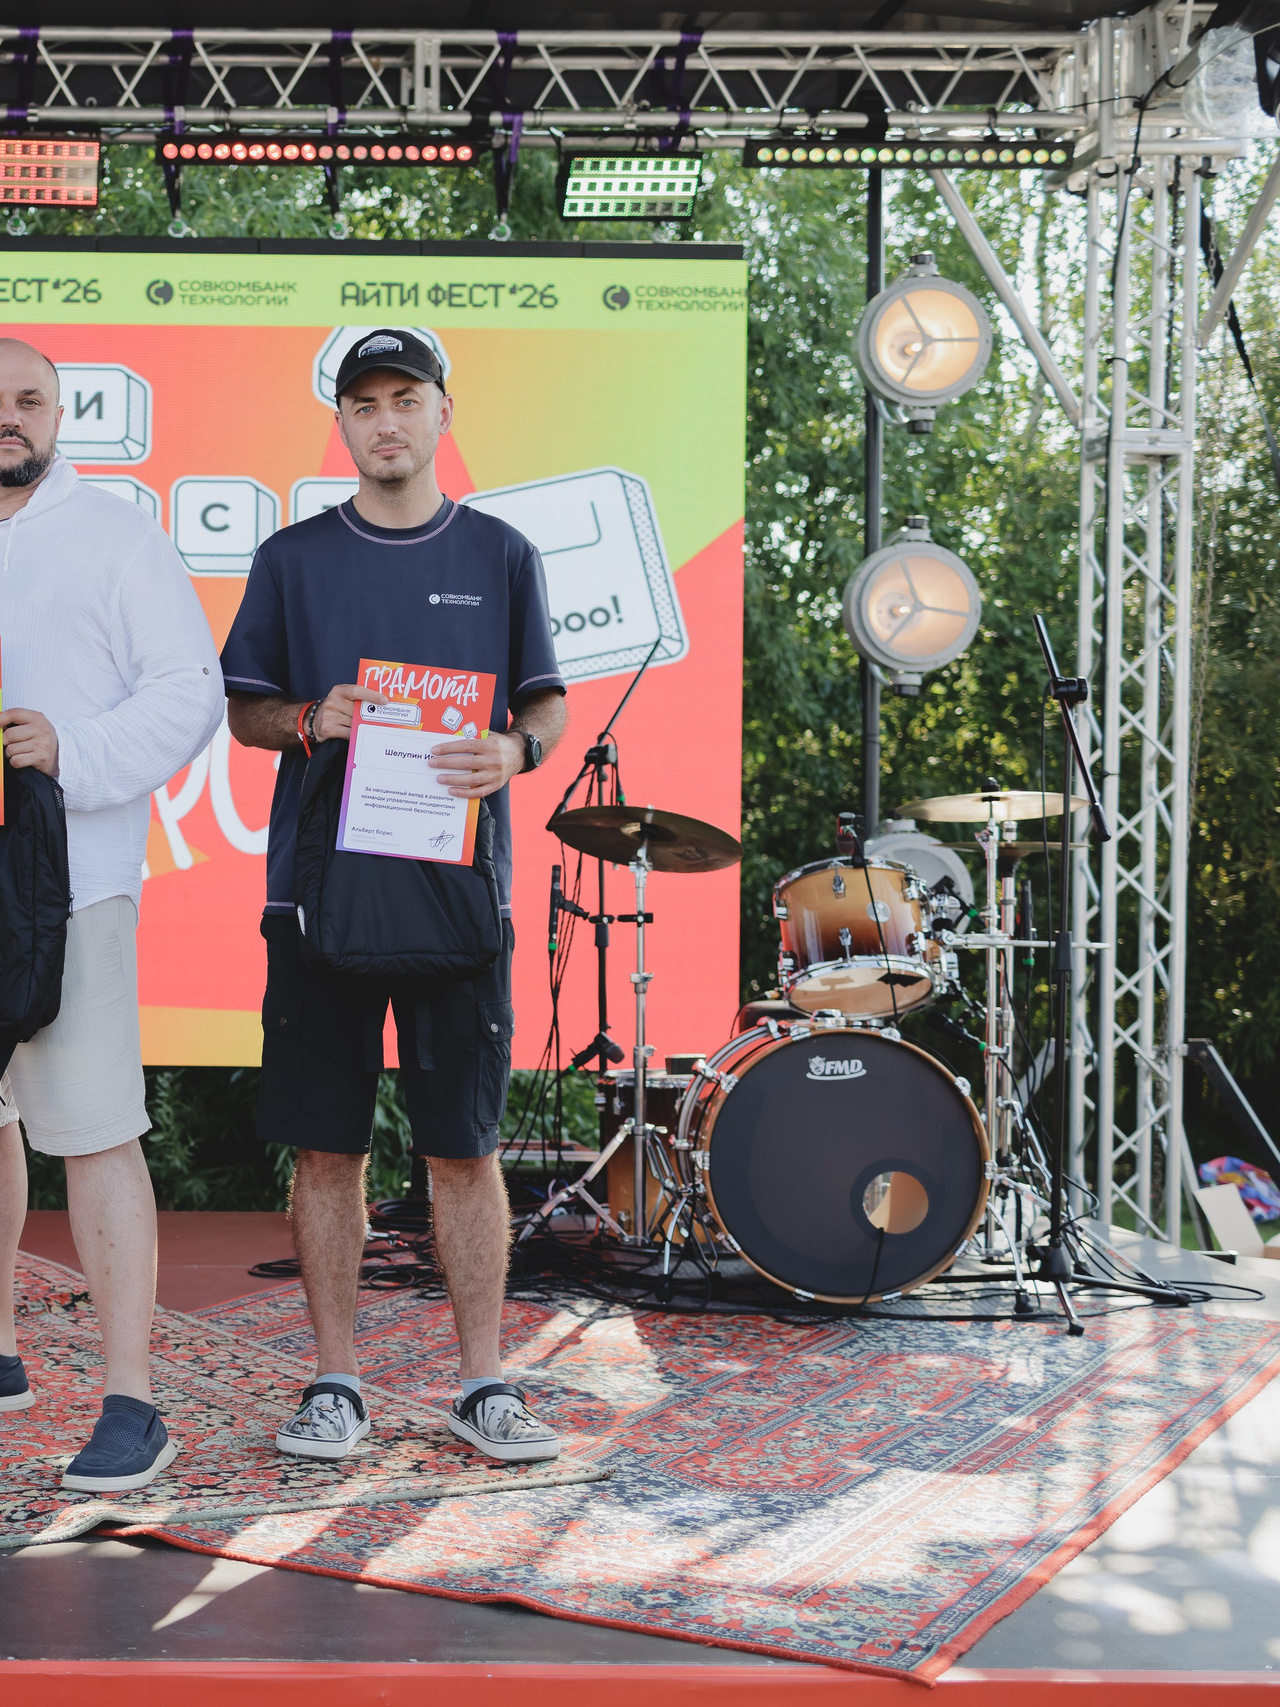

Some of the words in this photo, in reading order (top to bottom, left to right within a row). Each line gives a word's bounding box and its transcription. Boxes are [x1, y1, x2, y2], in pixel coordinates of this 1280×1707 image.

[178, 280, 297, 293] СОВКОМБАНК
[635, 285, 748, 297] СОВКОМБАН
[178, 293, 289, 306] ТЕХНОЛОГИИ
[636, 300, 745, 311] ТЕХНОЛОГИИ
[74, 391, 104, 420] И
[441, 593, 483, 602] СОВКОМБАНК
[385, 749, 423, 760] Шелупин
[824, 1058, 863, 1076] FMD
